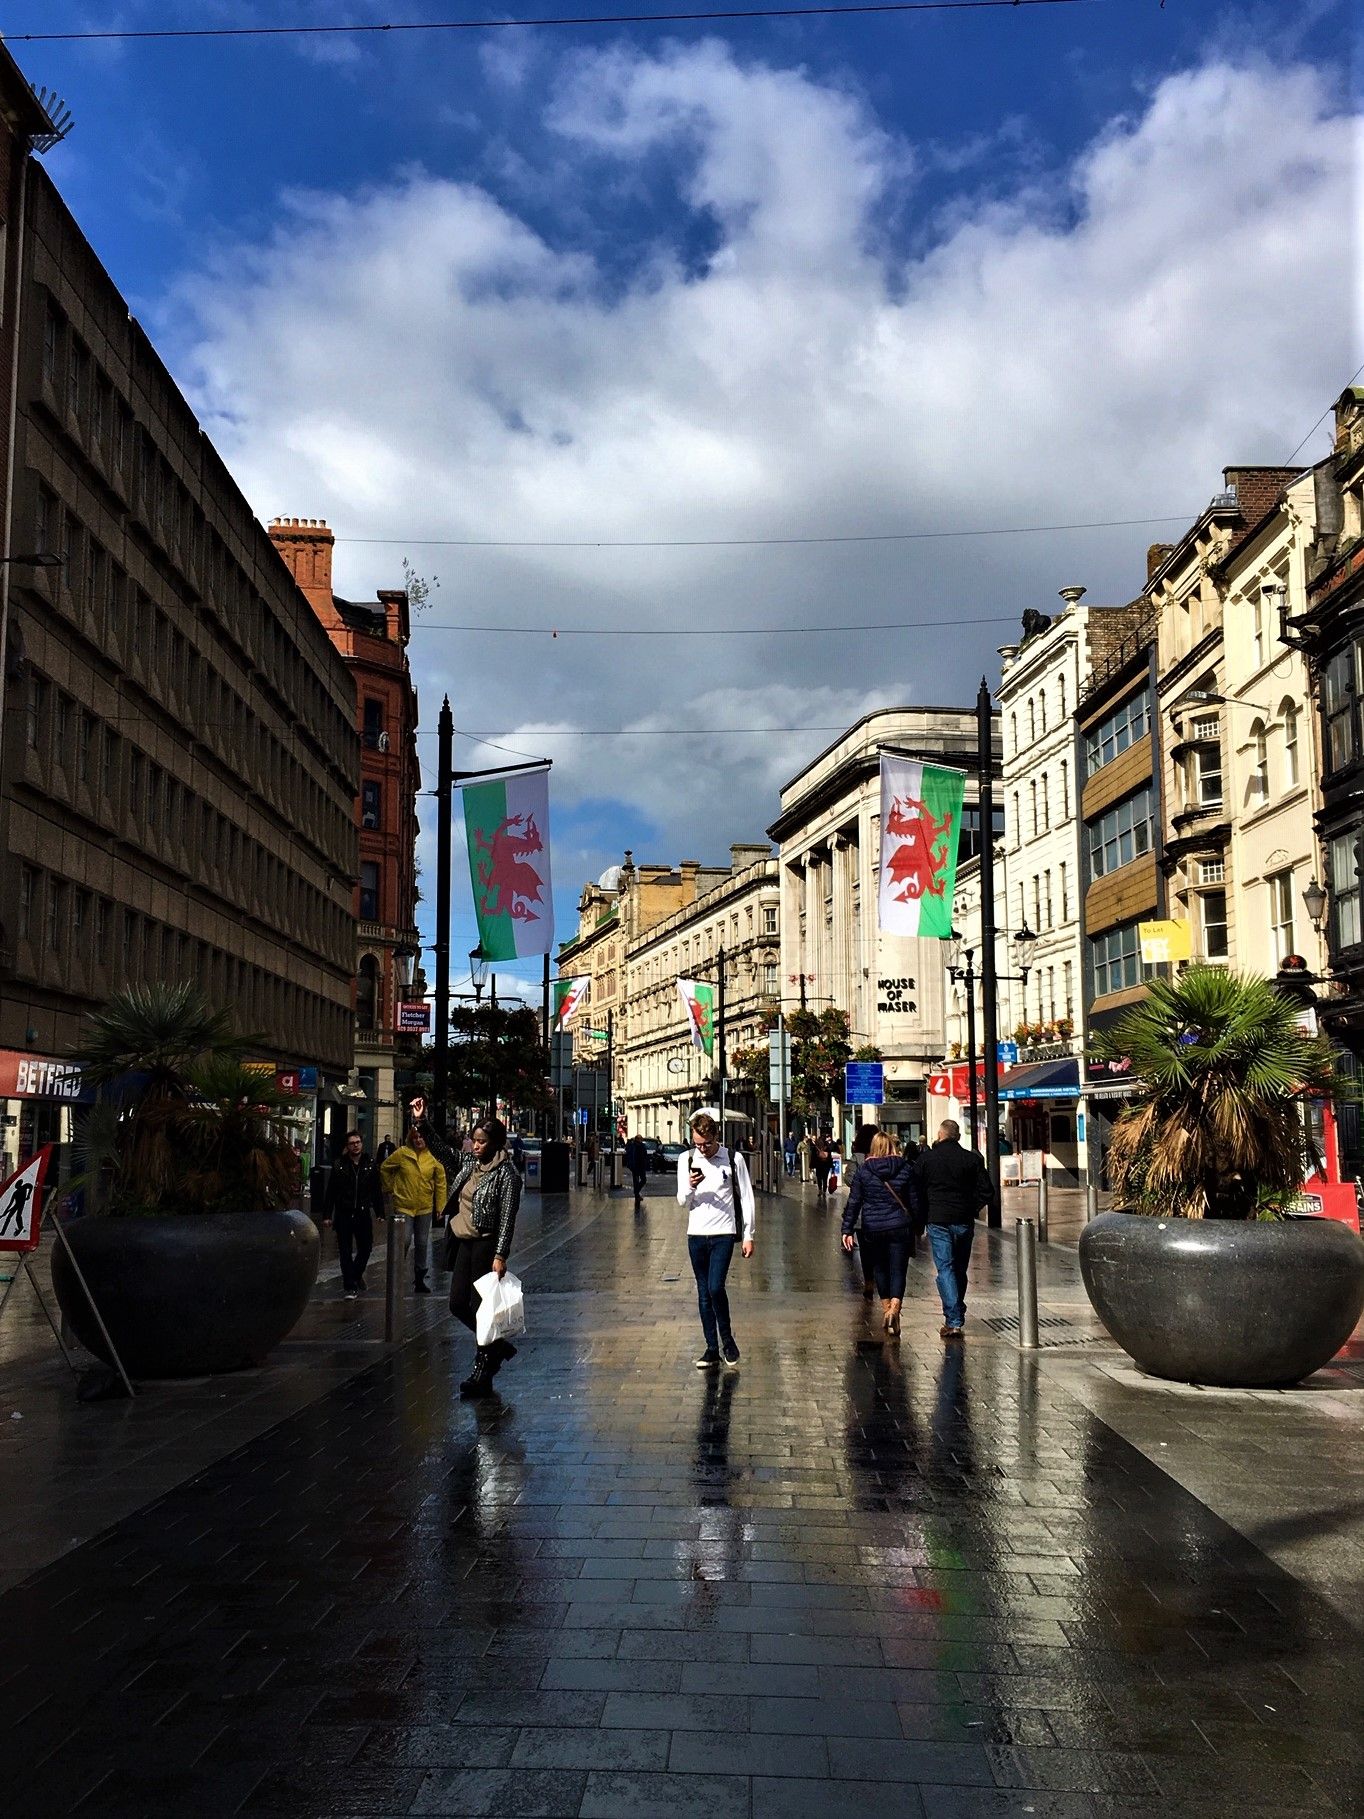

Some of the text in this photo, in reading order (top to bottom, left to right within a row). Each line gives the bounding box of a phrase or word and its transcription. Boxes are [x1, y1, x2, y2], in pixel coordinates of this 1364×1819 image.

[878, 978, 916, 991] HOUSE
[887, 990, 903, 1001] OF
[877, 1001, 917, 1013] FRASER
[16, 1060, 82, 1097] BETFRED
[1284, 1201, 1321, 1213] RAINS
